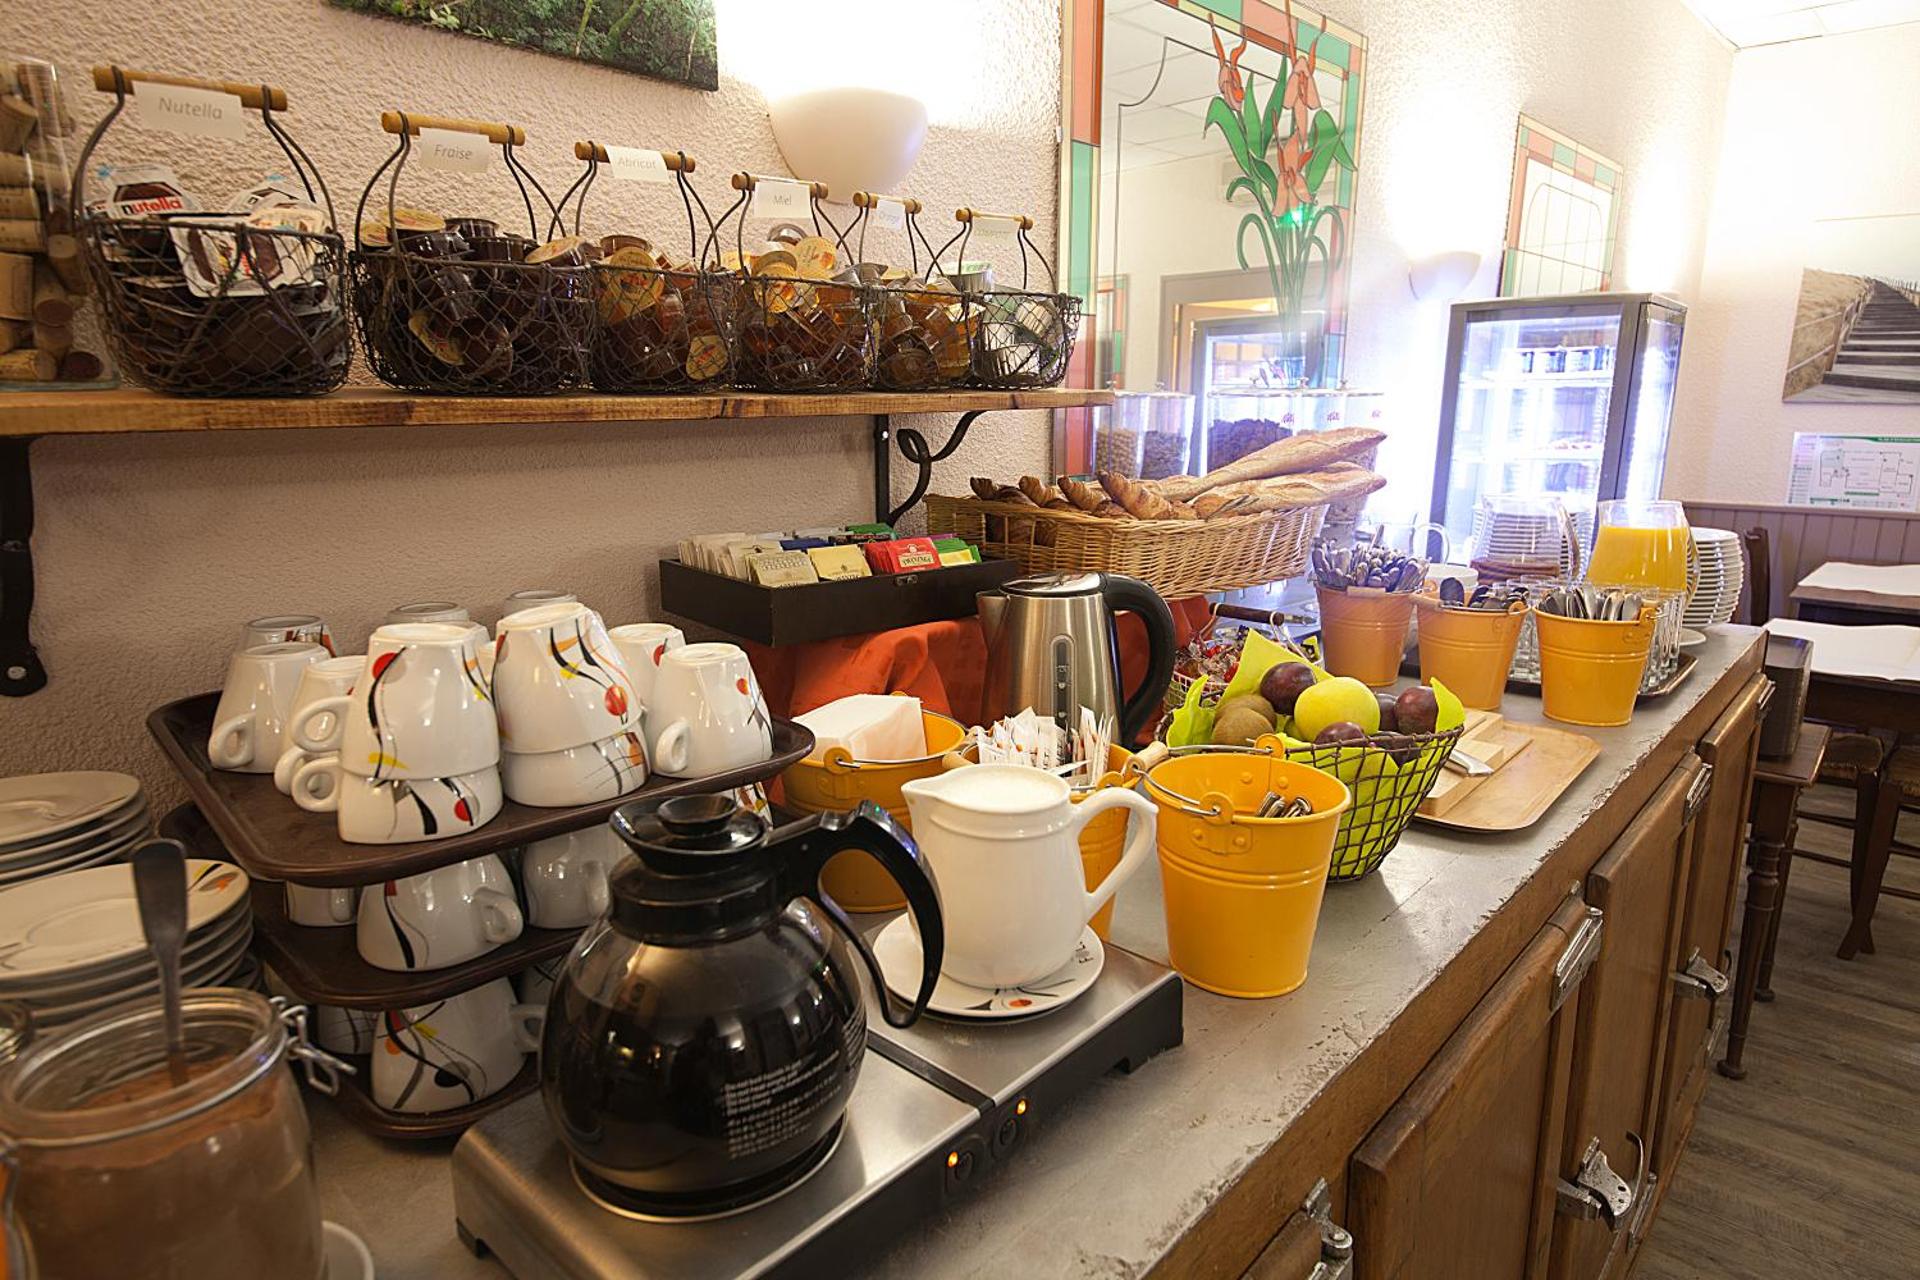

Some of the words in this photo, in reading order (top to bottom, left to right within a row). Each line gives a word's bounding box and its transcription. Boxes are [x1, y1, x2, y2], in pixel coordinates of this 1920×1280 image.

[158, 97, 223, 120] Nutella
[433, 143, 473, 160] Fraise
[121, 197, 183, 215] nutella
